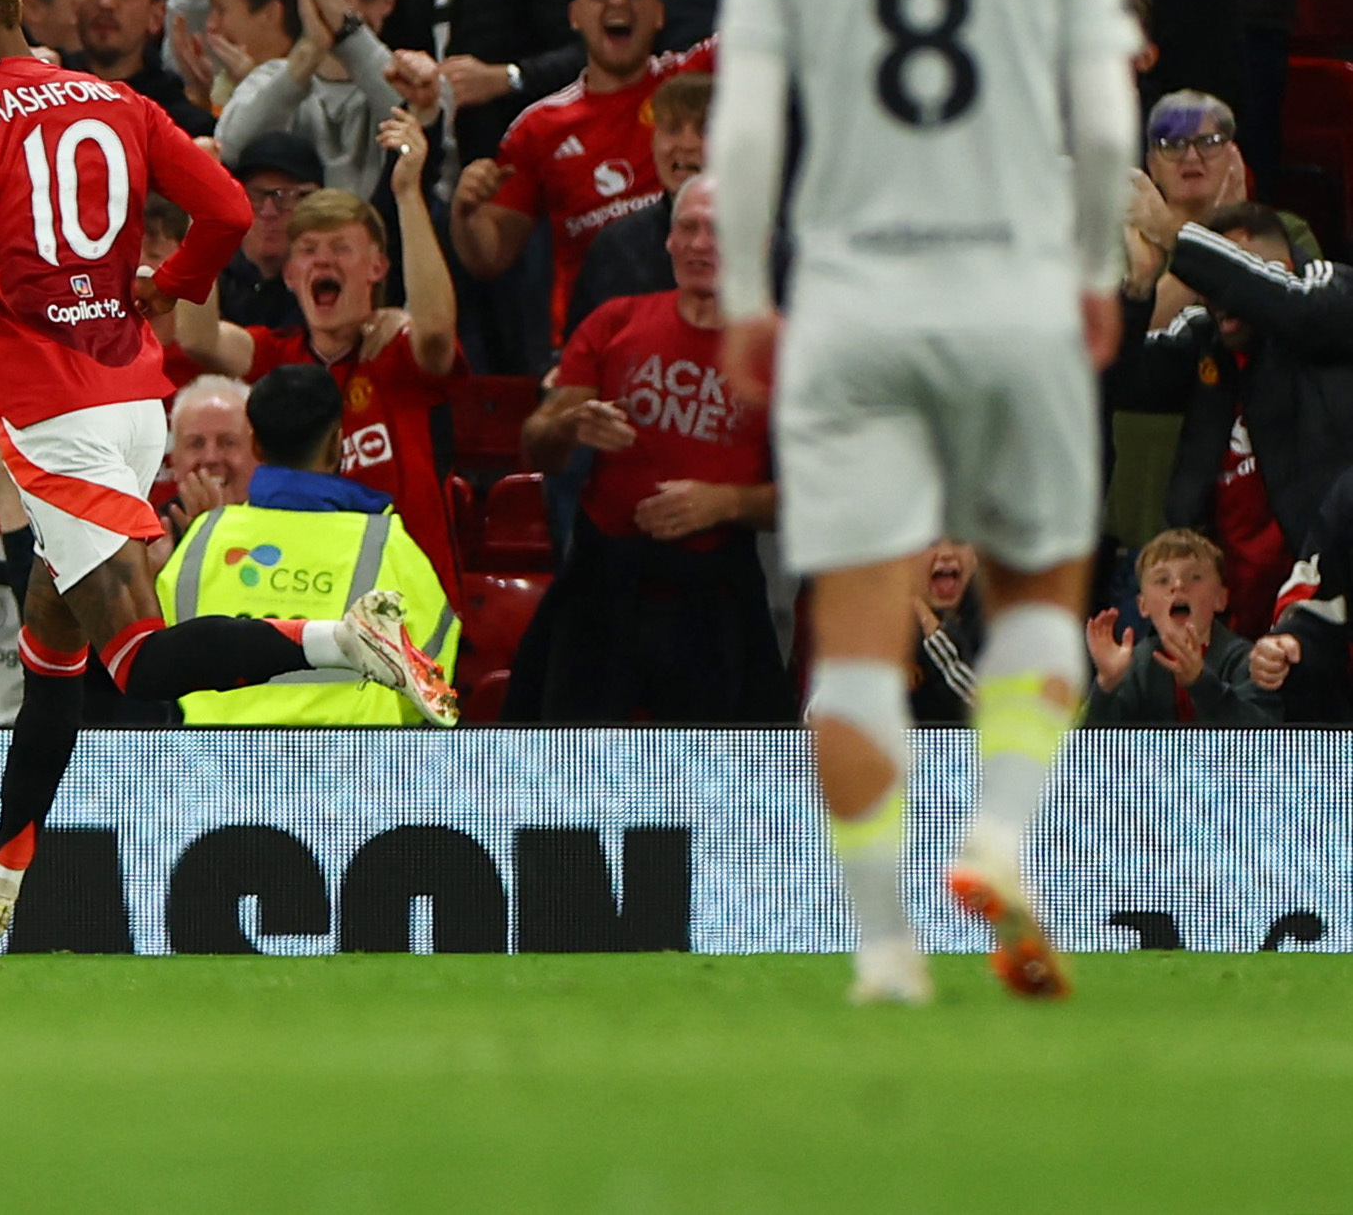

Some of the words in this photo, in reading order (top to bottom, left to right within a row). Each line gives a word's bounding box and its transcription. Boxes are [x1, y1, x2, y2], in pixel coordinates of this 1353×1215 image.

[23, 118, 130, 267] 10
[630, 352, 729, 406] ACK
[627, 386, 737, 443] ONE
[270, 568, 333, 594] CSG
